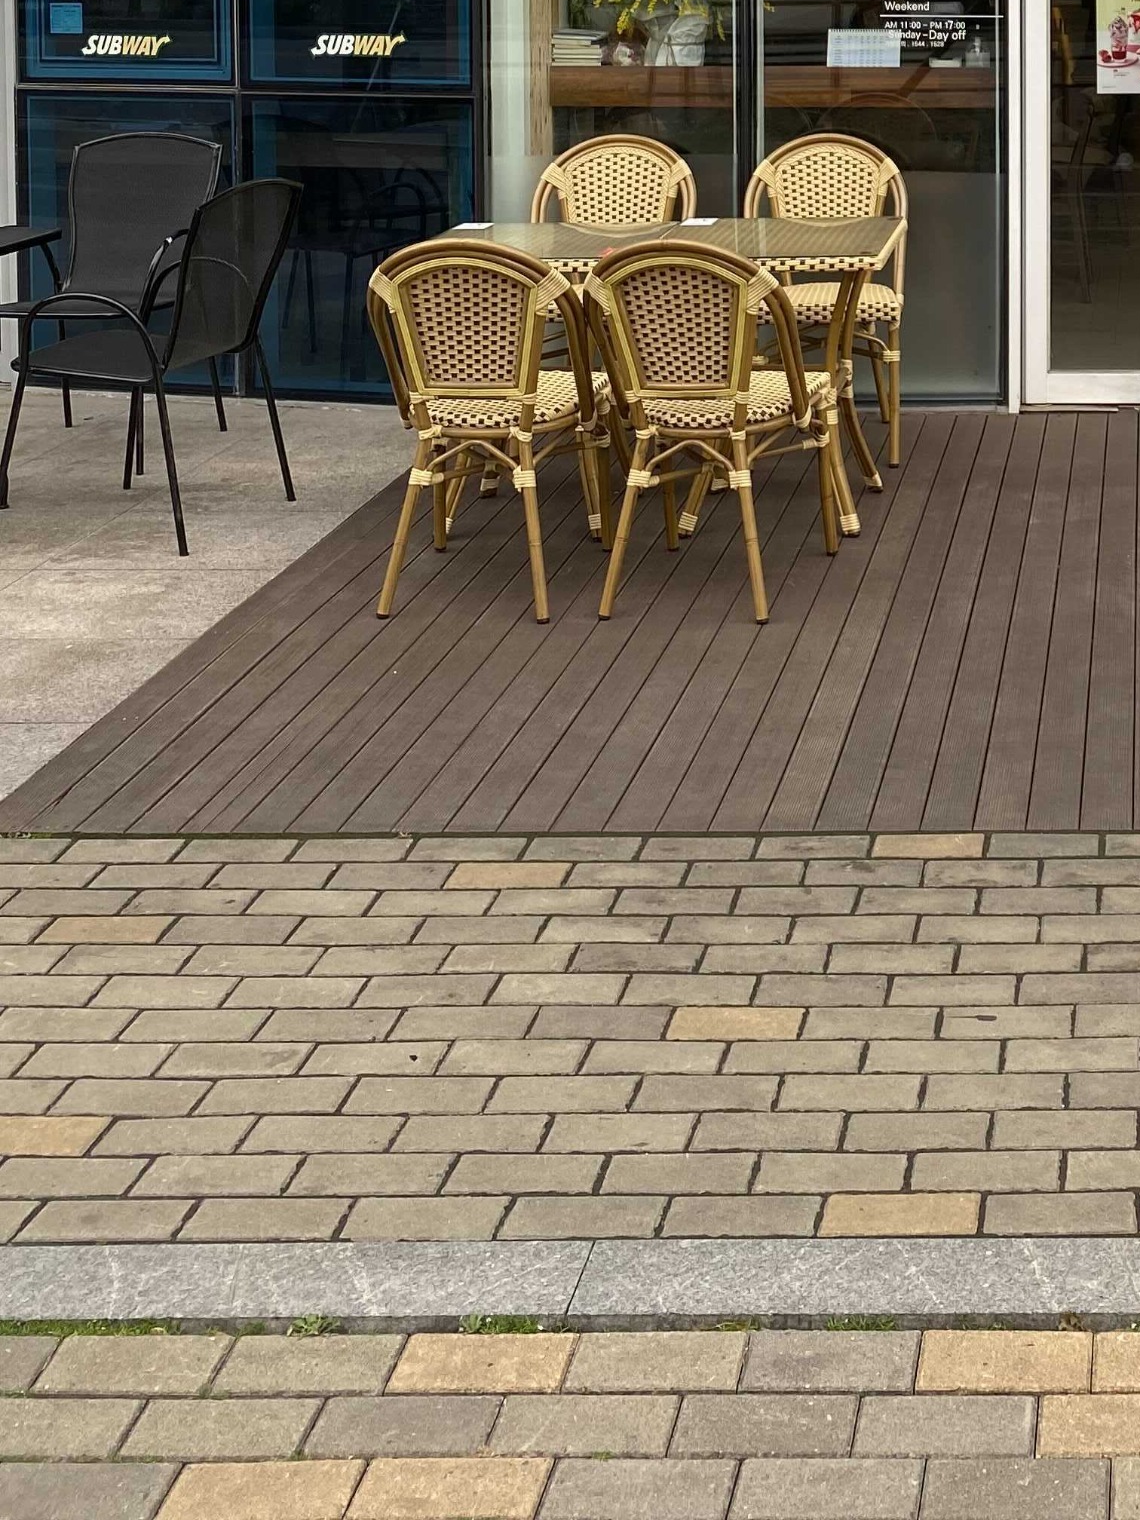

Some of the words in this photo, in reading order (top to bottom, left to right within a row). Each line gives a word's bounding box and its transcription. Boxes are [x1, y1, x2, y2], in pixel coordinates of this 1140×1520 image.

[884, 0, 930, 12] Weekend
[884, 21, 898, 29] AM
[929, 21, 943, 29] PM
[944, 20, 966, 29] 17:00
[928, 29, 950, 43] Day
[951, 29, 967, 41] off
[80, 34, 171, 57] SUBWAY
[309, 32, 407, 58] SUBWAY
